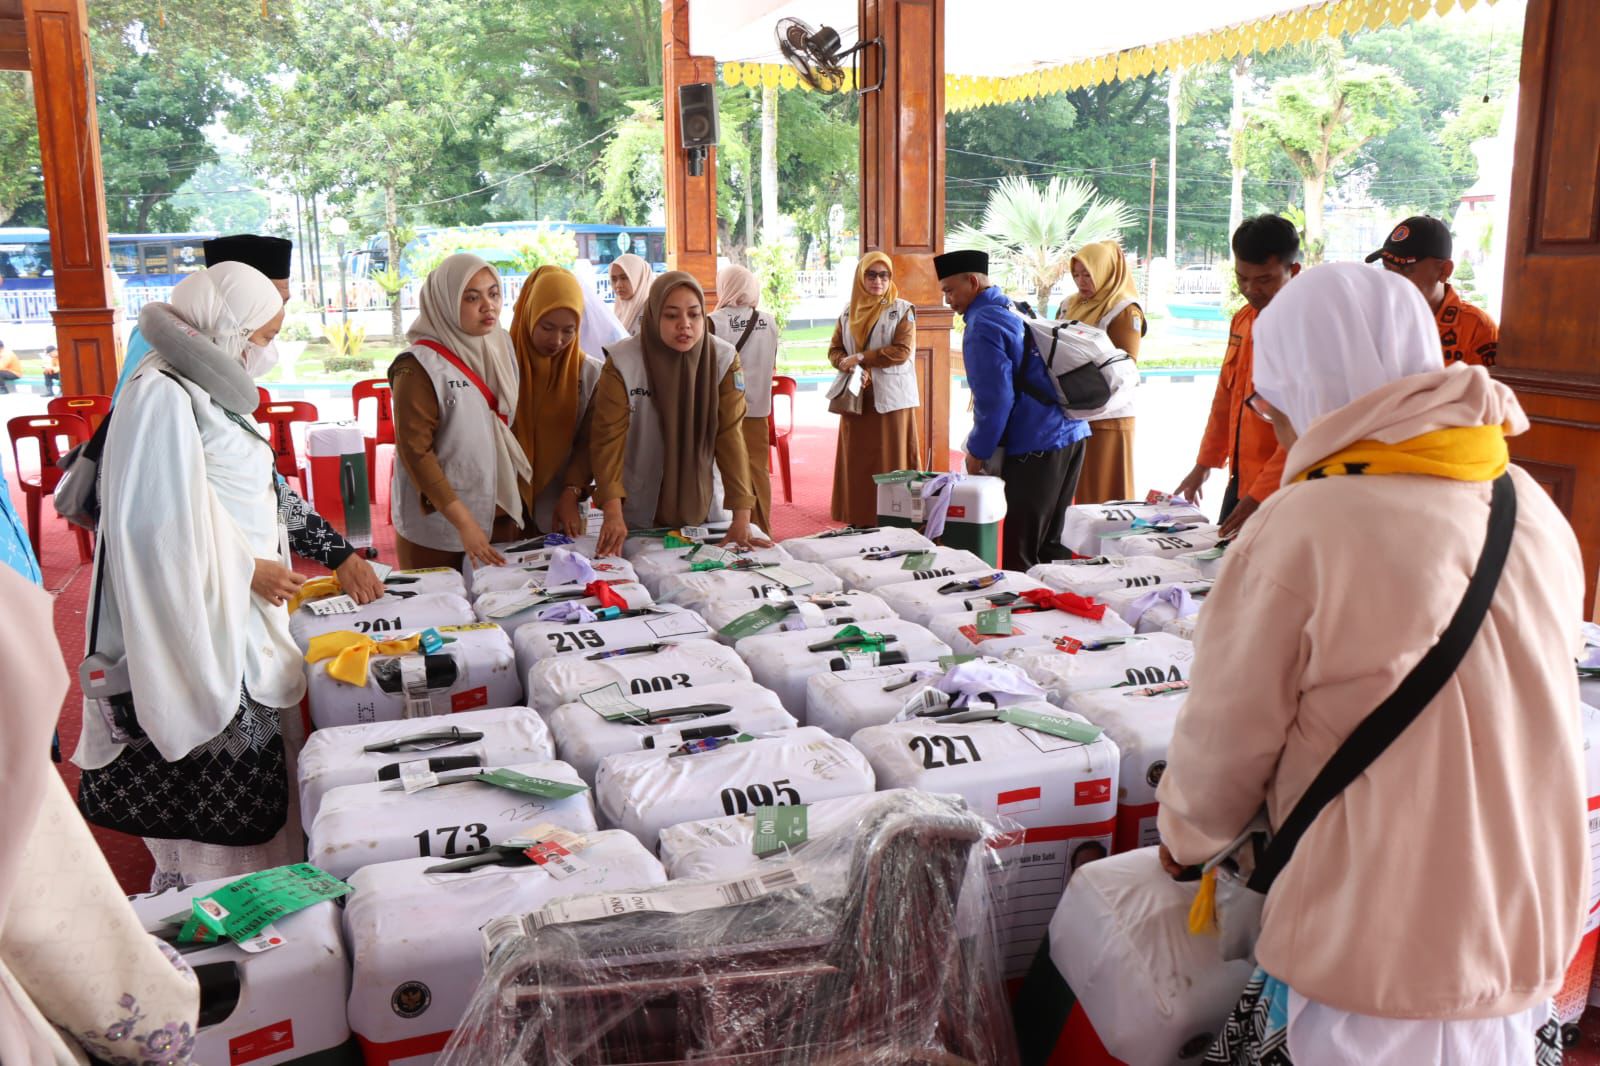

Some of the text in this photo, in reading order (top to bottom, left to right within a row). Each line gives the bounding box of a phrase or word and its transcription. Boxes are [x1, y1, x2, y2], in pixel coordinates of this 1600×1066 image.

[354, 616, 402, 632] 201
[547, 629, 605, 653] 219
[630, 673, 693, 695] 003
[908, 735, 982, 770] 227
[720, 779, 801, 816] 095
[413, 822, 491, 858] 173
[610, 896, 625, 914] KNO
